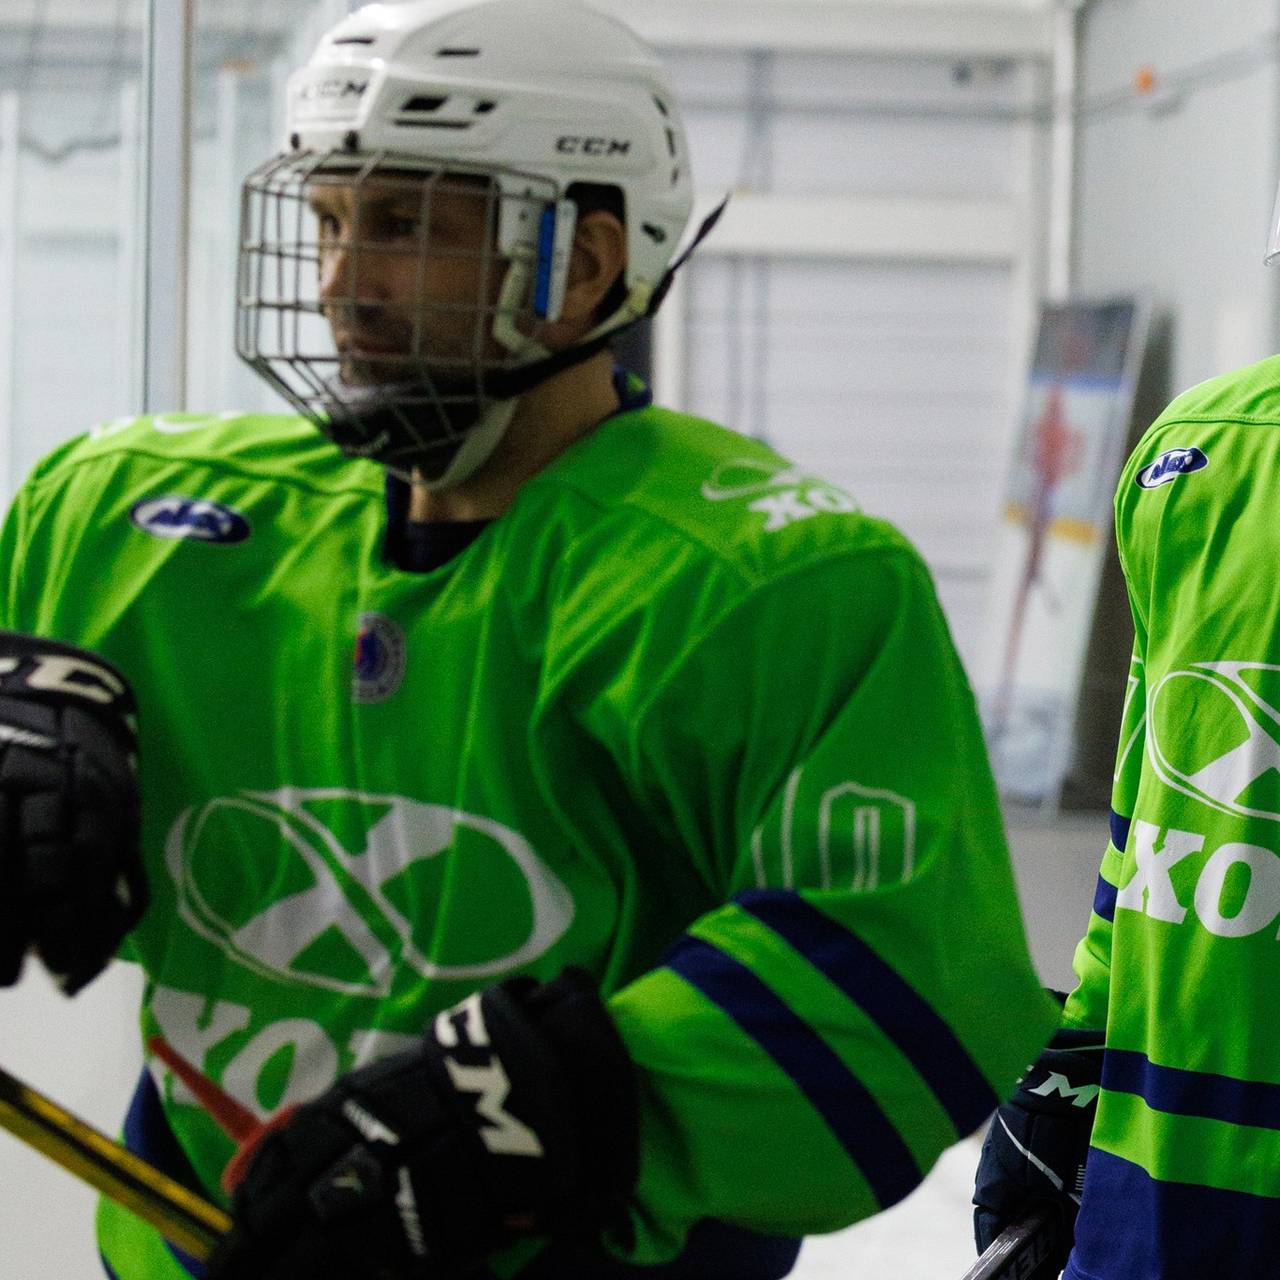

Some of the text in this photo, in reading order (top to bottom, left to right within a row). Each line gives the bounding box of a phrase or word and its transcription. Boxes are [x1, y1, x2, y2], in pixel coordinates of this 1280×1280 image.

[555, 134, 631, 157] CCM
[747, 489, 857, 533] ХО
[150, 984, 428, 1123] ХО
[435, 993, 544, 1158] CM
